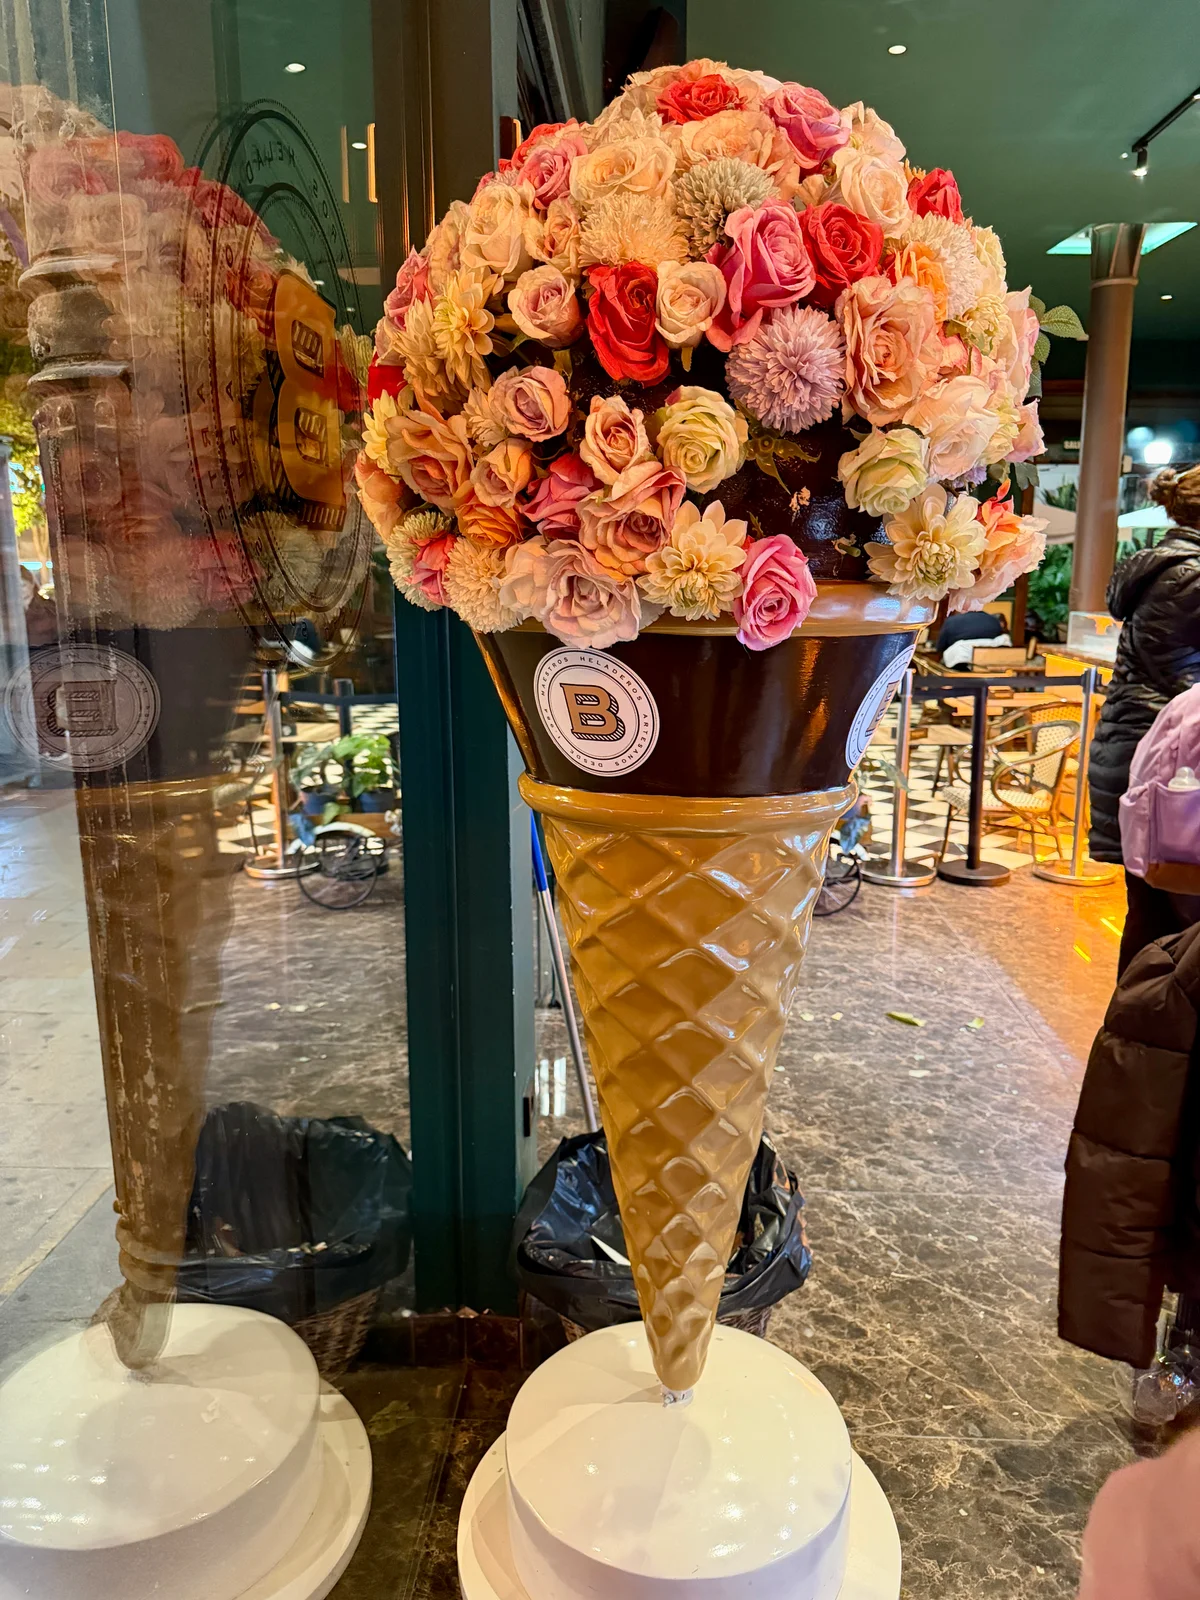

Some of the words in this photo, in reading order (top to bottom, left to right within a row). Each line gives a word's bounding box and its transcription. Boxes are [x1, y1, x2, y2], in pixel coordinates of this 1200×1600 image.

[1063, 440, 1081, 450] SALI
[541, 656, 569, 697] MAESTROS
[579, 655, 643, 701] HELADEROS
[559, 683, 626, 742] B
[569, 748, 604, 768] DESDE
[614, 713, 649, 767] ARTESANOS
